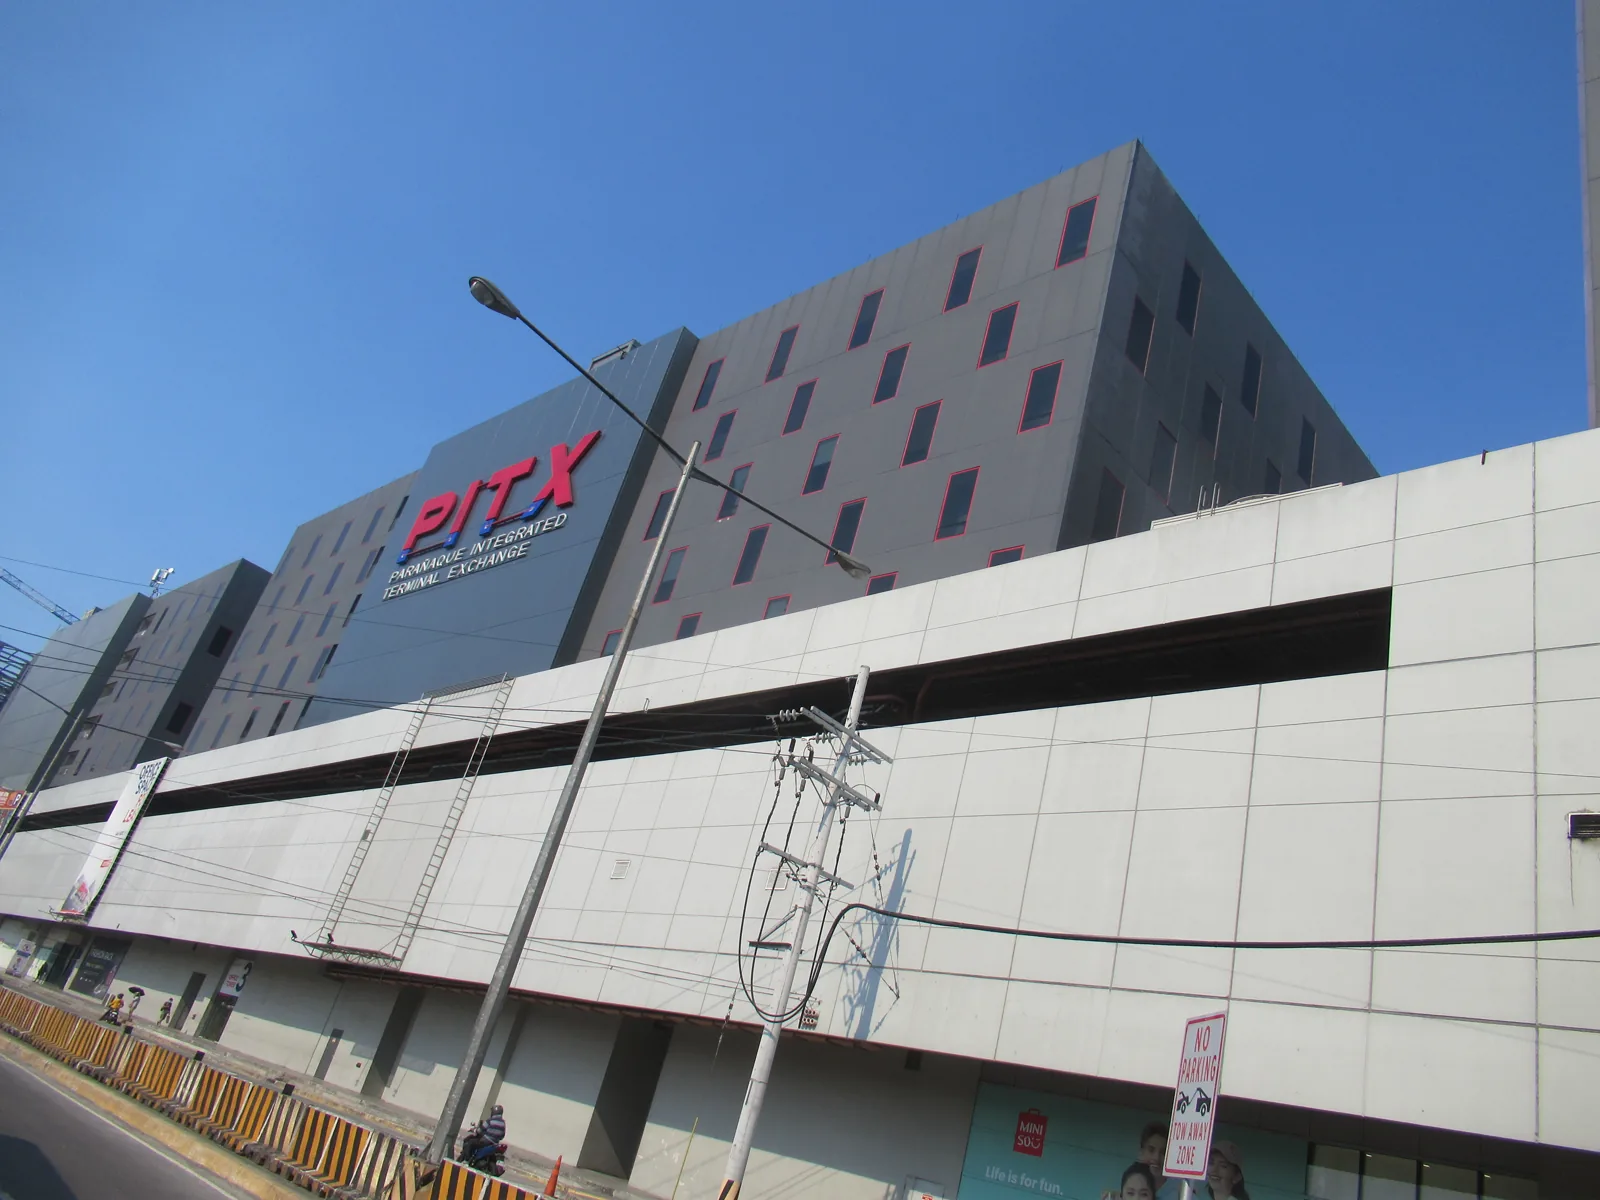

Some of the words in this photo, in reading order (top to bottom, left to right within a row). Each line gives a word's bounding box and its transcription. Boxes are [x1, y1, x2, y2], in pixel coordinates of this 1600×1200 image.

[396, 430, 602, 564] PITX
[388, 546, 466, 584] PARAÑAQUE
[469, 512, 569, 556] INTEGRATED
[382, 571, 441, 600] TERMINAL
[447, 541, 532, 580] EXCHANGE
[1194, 1025, 1211, 1052] NO
[1180, 1055, 1217, 1083] PARKING
[1019, 1121, 1044, 1135] MINI
[1172, 1122, 1187, 1141] TOW
[1188, 1122, 1209, 1141] AWAY
[1176, 1145, 1196, 1166] ZONE
[985, 1165, 1006, 1182] Life
[1007, 1169, 1018, 1184] is
[1020, 1172, 1038, 1189] for
[1039, 1177, 1064, 1196] fun.
